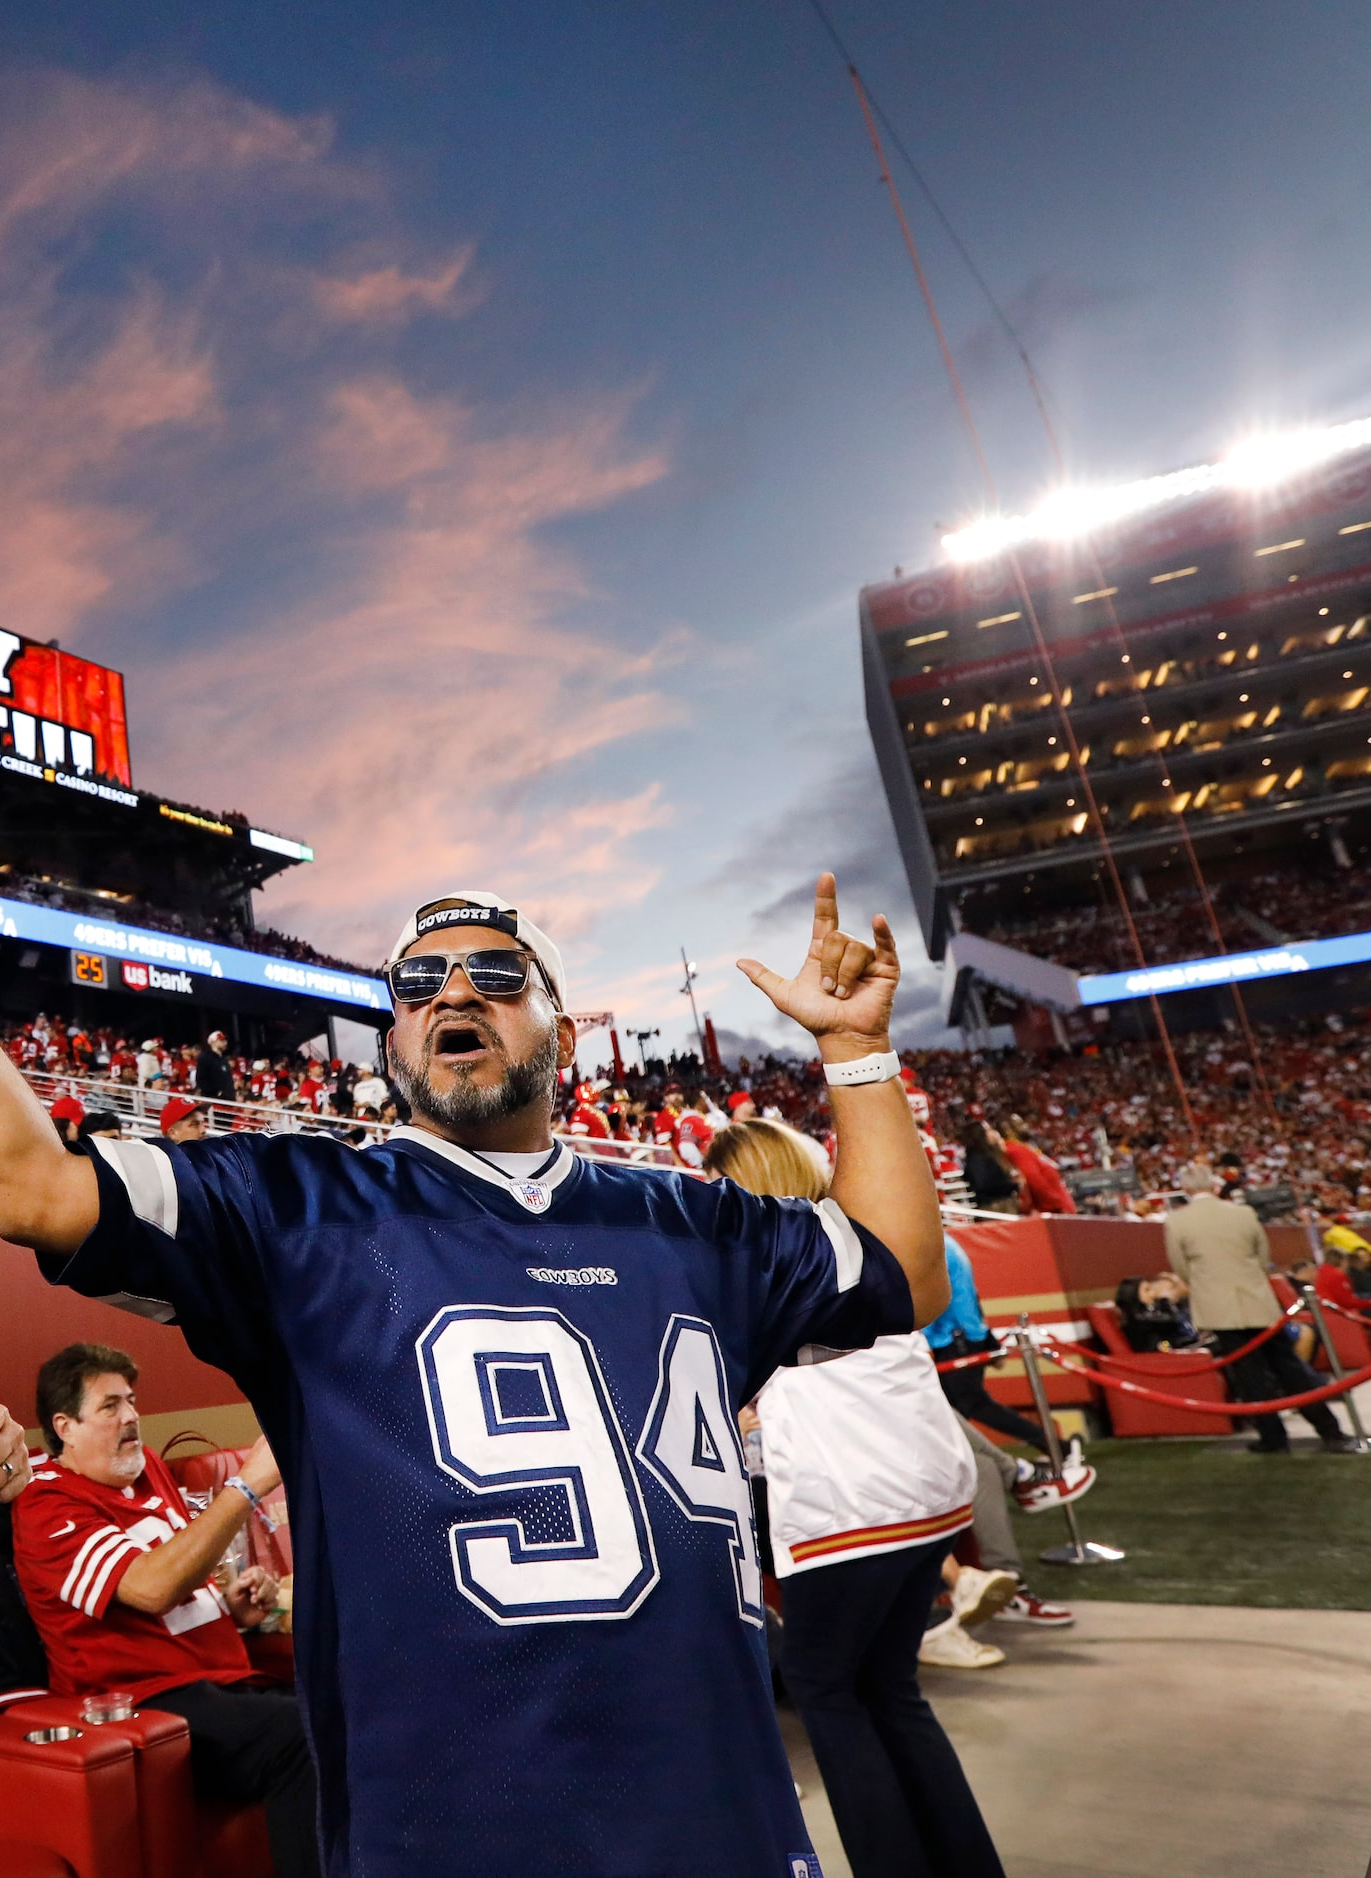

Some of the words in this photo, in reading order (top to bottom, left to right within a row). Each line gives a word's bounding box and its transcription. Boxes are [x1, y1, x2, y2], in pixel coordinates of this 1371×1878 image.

[1, 755, 44, 779] CREEK
[55, 771, 99, 796] CASINO
[98, 785, 139, 807] RESORT
[417, 908, 491, 931] COWBOYS
[74, 923, 128, 950] 49ERS
[128, 934, 187, 965] PREFER
[76, 954, 104, 983] 25
[264, 962, 306, 988] 49ERS
[306, 972, 353, 998] PREFER
[525, 1194, 544, 1206] NFL
[526, 1265, 618, 1287] COWBOYS
[415, 1303, 764, 1629] 94
